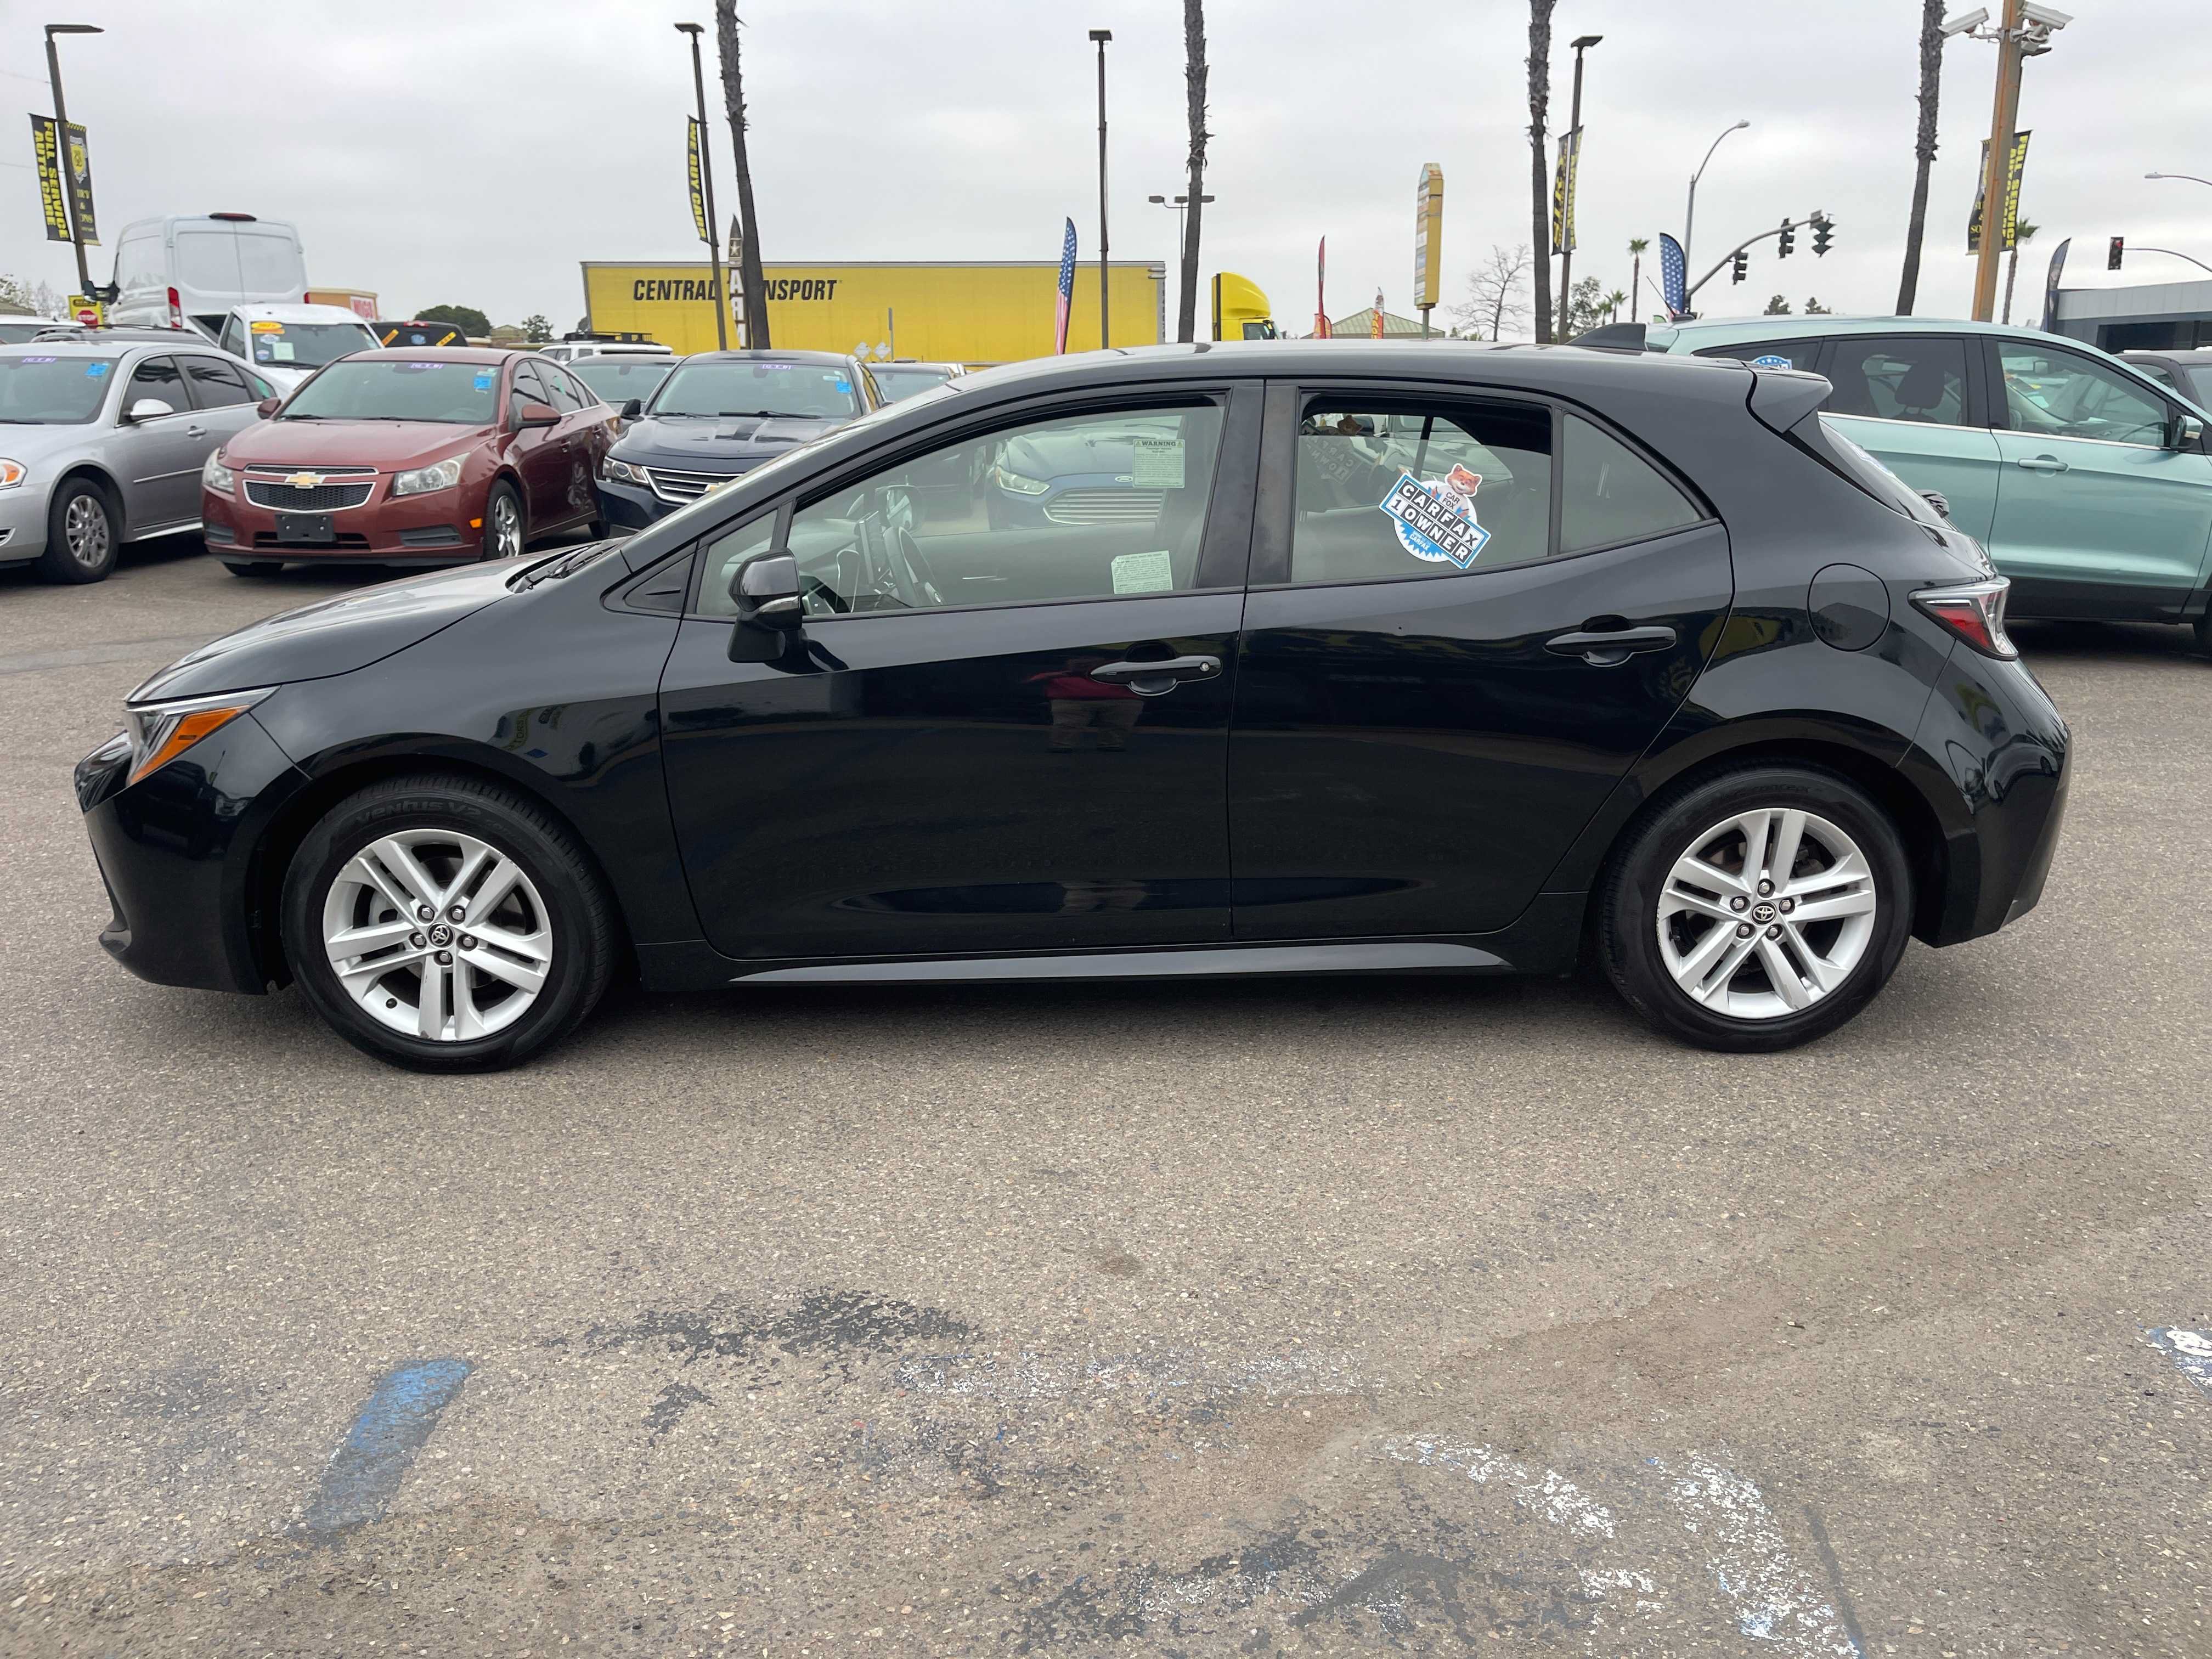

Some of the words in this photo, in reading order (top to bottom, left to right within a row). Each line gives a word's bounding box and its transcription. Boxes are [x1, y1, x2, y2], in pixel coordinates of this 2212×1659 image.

[35, 130, 48, 177] AUTO
[44, 121, 55, 159] FULL
[2015, 135, 2028, 171] FULL
[689, 153, 700, 190] BUY
[41, 181, 56, 225] CARE
[48, 167, 69, 238] SERVICE
[692, 193, 707, 238] CARS
[2006, 179, 2020, 247] SERVICE
[633, 279, 715, 301] CENTRAL
[1402, 484, 1479, 547] CARFAX
[1442, 498, 1455, 510] FOX
[1446, 492, 1460, 505] CAR
[1391, 499, 1402, 511] 1
[1404, 510, 1469, 560] OWNER
